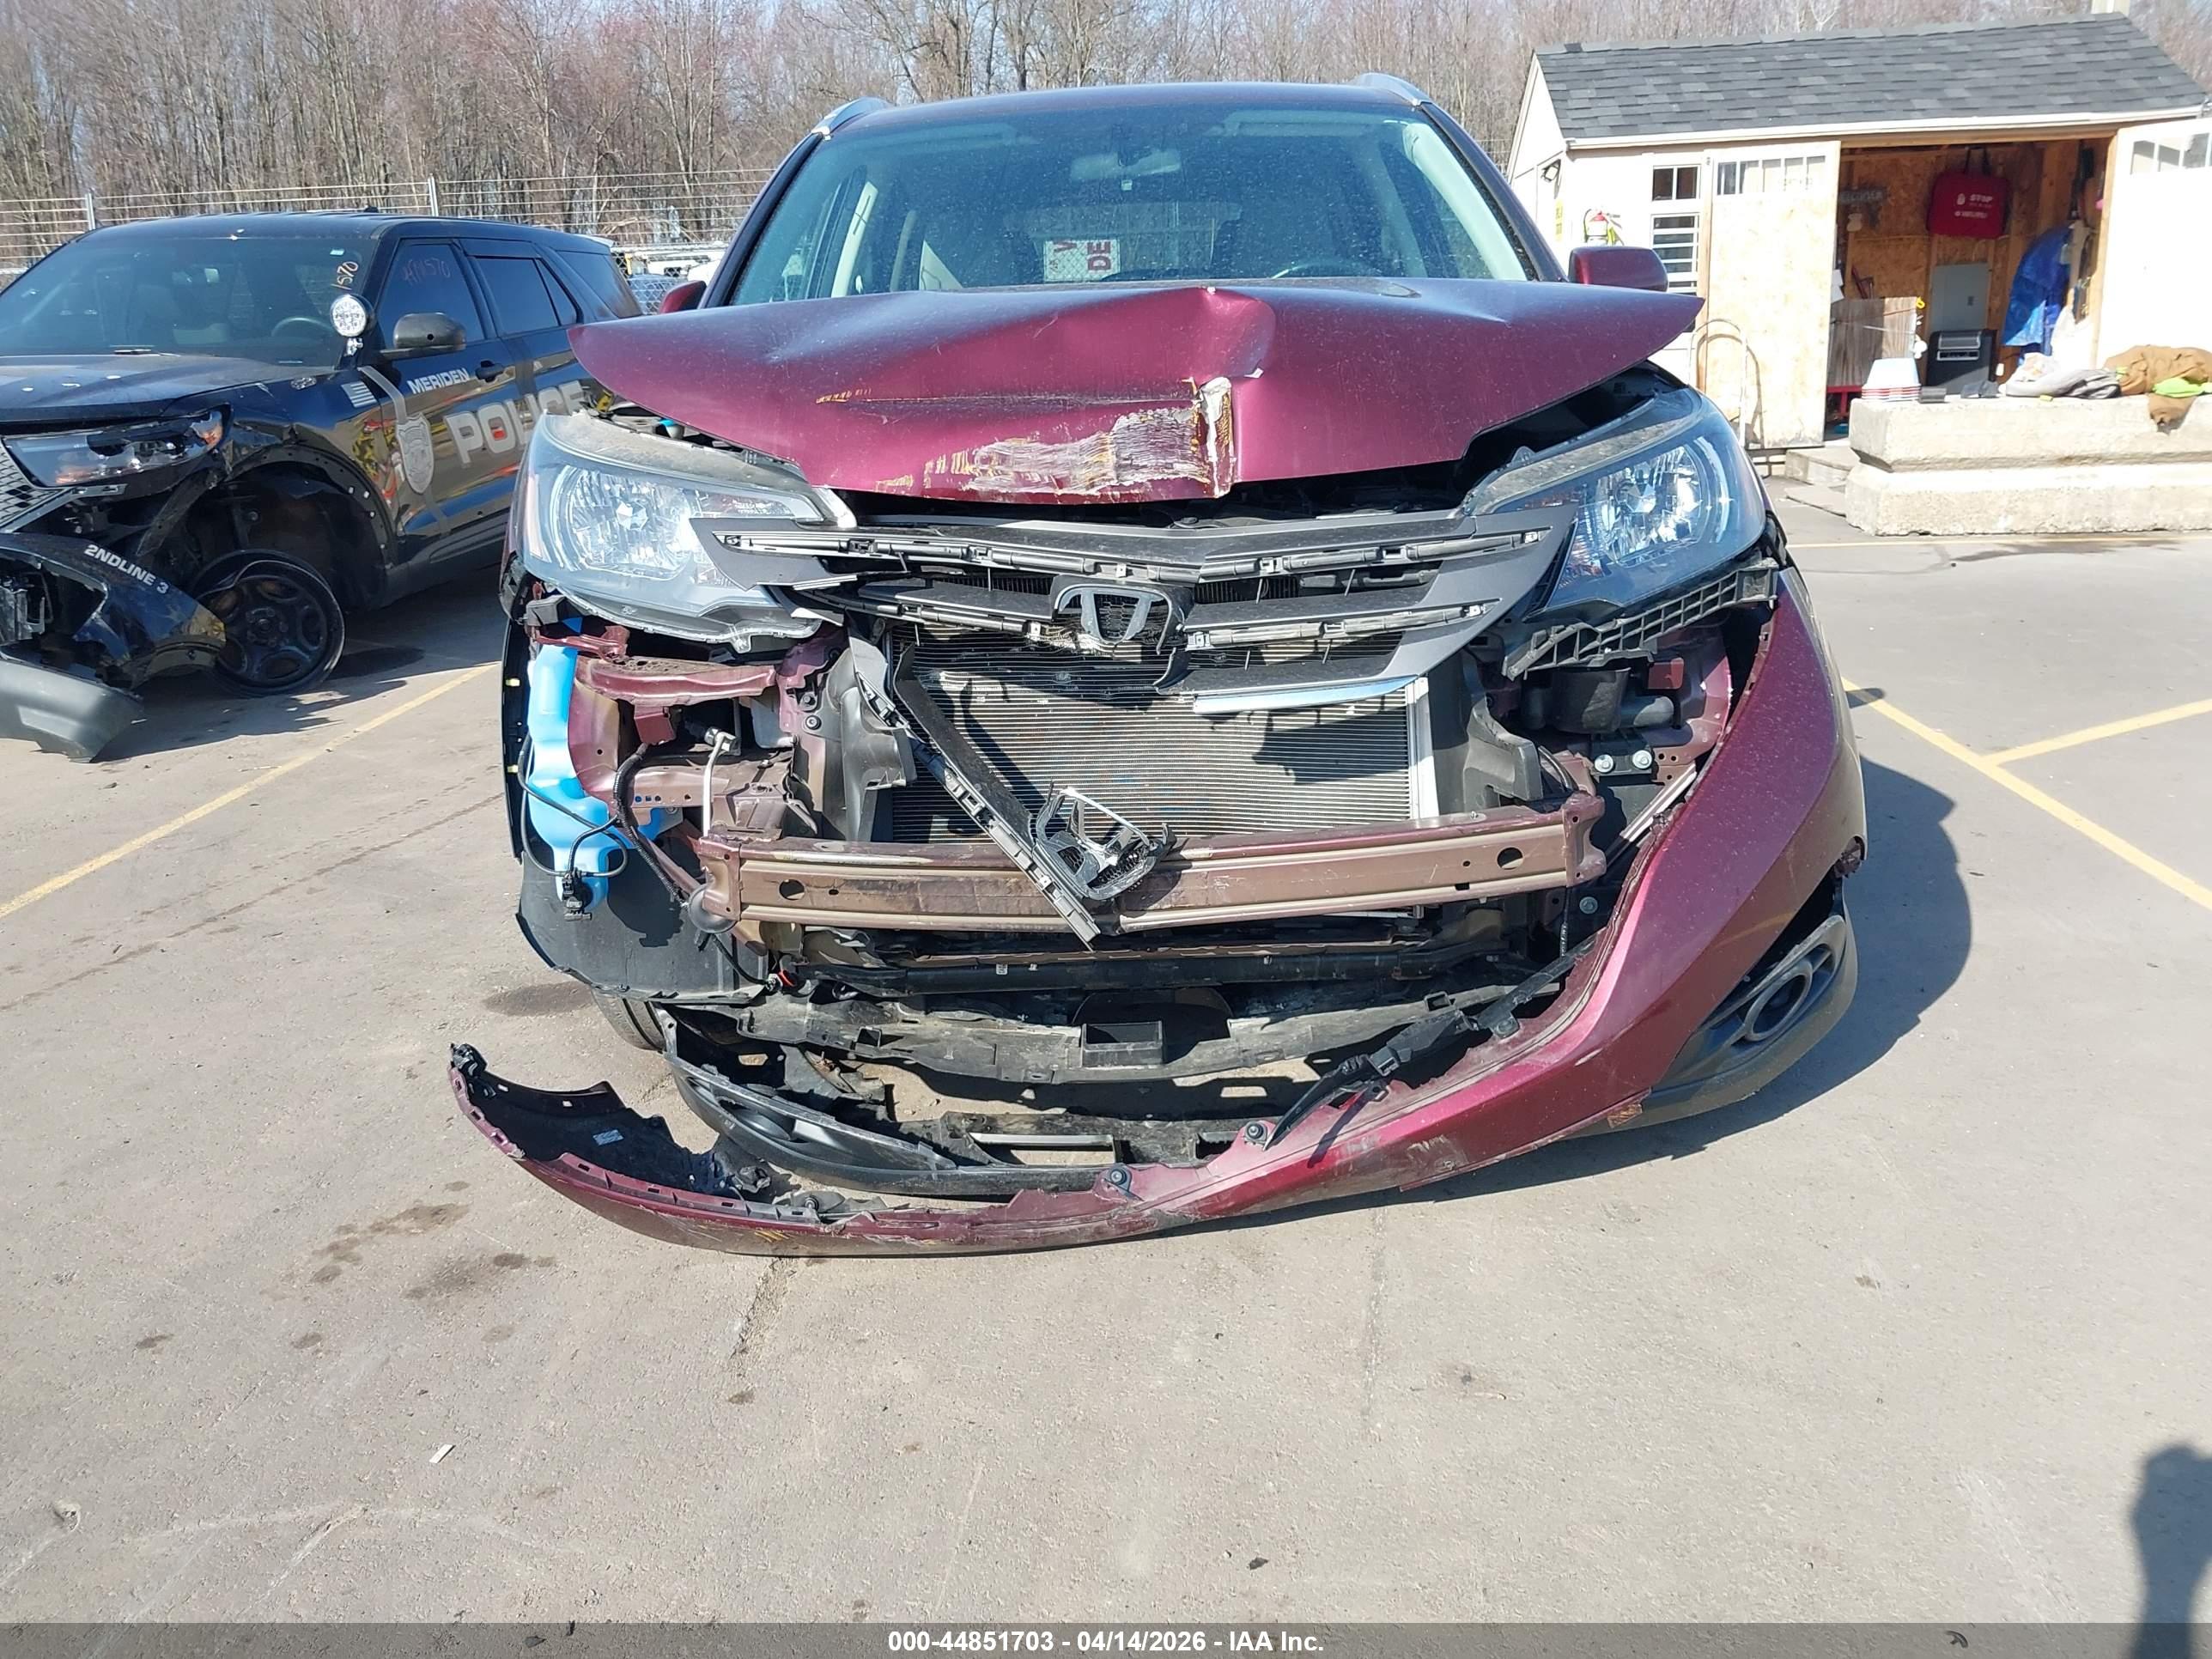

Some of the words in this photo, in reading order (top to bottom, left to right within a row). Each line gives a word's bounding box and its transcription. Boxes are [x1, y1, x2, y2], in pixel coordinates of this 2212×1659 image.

[331, 260, 359, 290] 1570
[407, 368, 471, 394] MERIDEN
[445, 380, 585, 466] POLICE
[84, 544, 156, 586] 2NDLINE
[157, 581, 169, 594] 3
